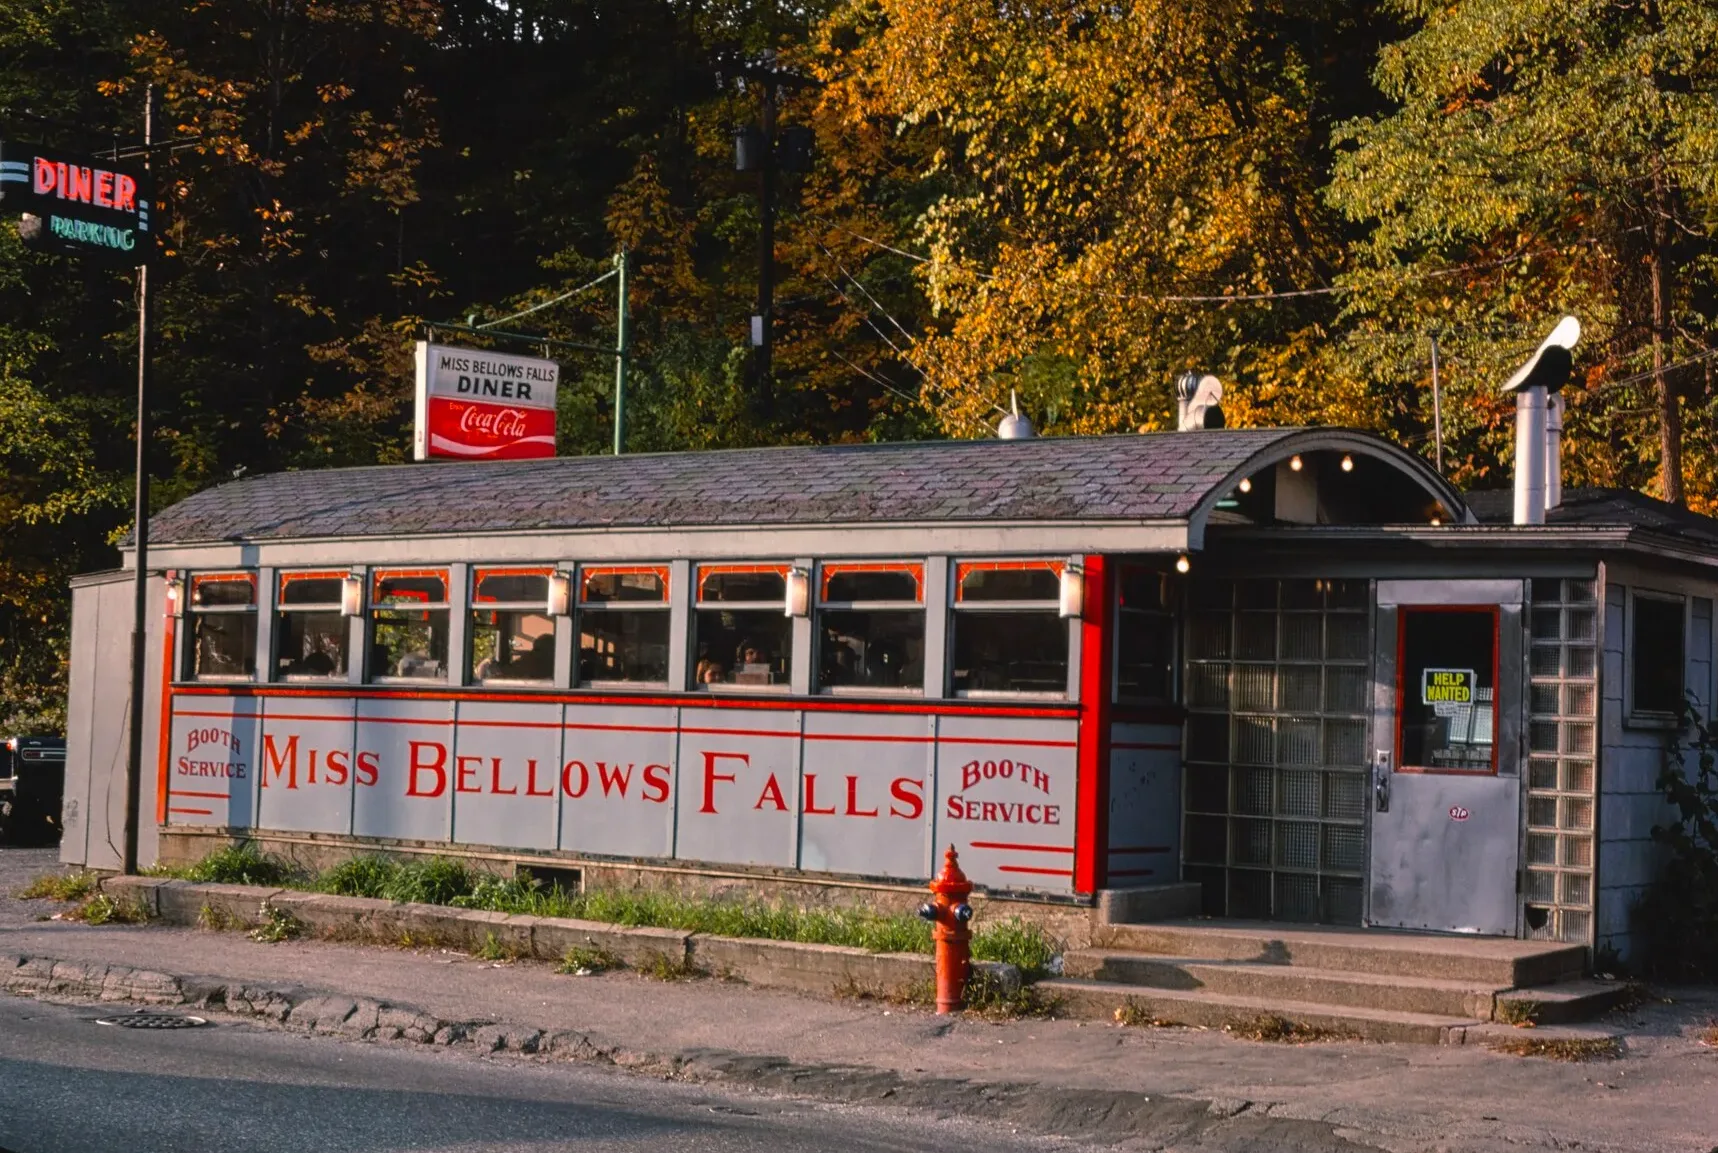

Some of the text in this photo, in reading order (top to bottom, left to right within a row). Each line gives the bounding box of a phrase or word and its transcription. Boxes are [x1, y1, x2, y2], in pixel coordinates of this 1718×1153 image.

[33, 156, 137, 213] DINER
[50, 214, 136, 251] PARKING
[440, 355, 556, 382] MISS BELLOWS FALLS
[457, 375, 533, 400] DINER
[1433, 672, 1465, 686] HELP
[1426, 685, 1471, 702] WANTED
[187, 727, 241, 755] BOOTH
[178, 756, 247, 779] SERVICE
[261, 734, 924, 820] MISS BELLOWS FALLS
[961, 758, 1051, 795] BOOTH
[946, 794, 1061, 825] SERVICE
[1450, 808, 1469, 820] STP
